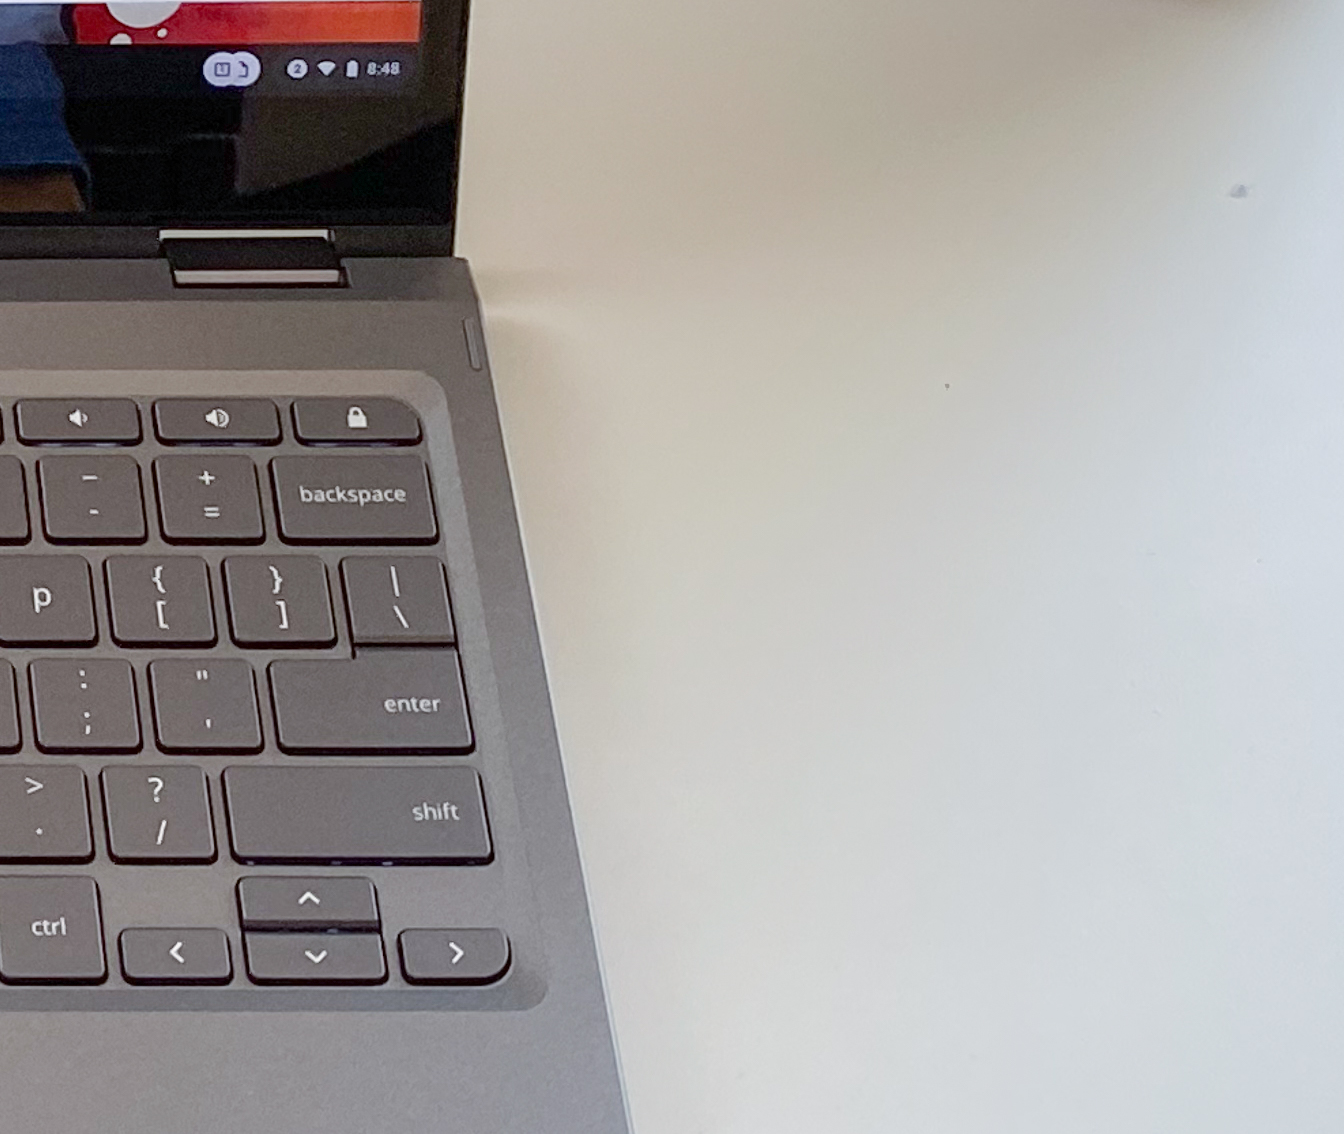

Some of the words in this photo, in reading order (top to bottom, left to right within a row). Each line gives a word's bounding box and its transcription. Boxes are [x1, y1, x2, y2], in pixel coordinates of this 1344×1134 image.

[300, 486, 405, 506] backspace
[385, 698, 440, 712] enter
[413, 802, 459, 820] shift
[32, 918, 66, 935] ctrl
